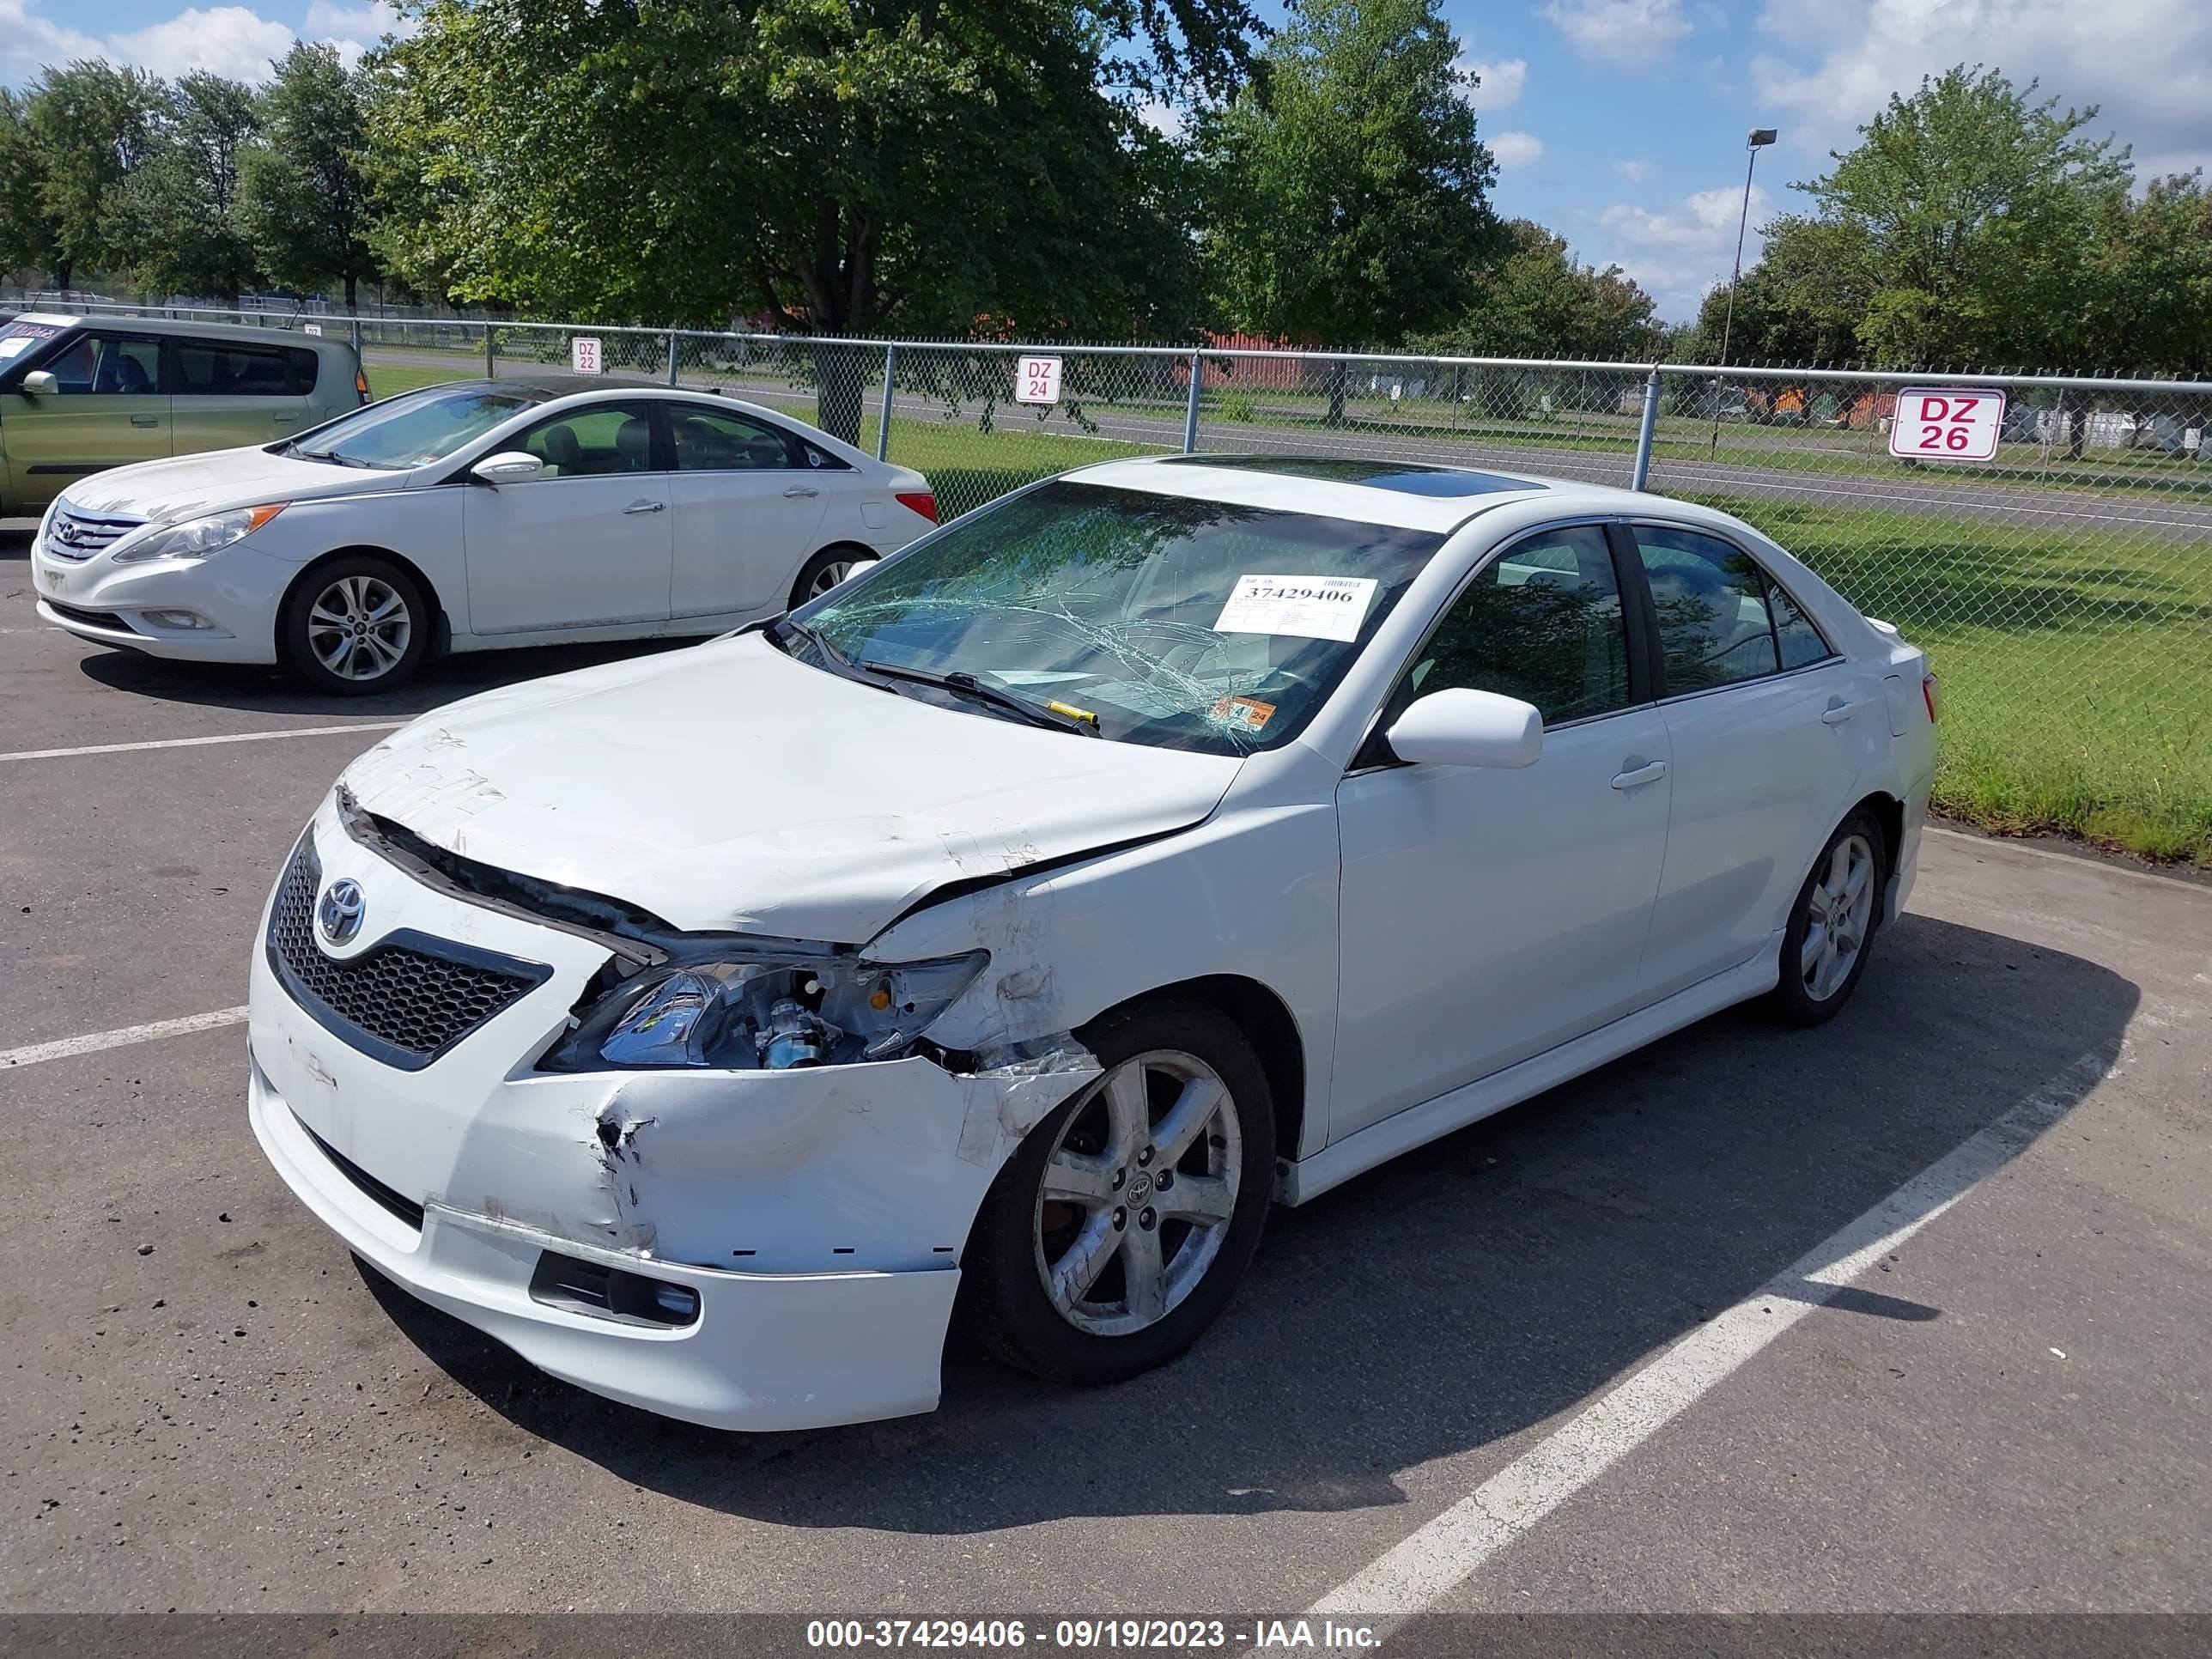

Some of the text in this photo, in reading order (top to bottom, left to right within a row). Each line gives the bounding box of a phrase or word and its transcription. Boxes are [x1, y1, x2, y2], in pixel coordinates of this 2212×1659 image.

[579, 343, 594, 355] DZ
[580, 356, 594, 368] 22
[1029, 362, 1052, 379] DZ
[1029, 380, 1047, 397] 24
[1920, 398, 1979, 423] DZ
[1918, 425, 1969, 451] 26
[1244, 587, 1354, 603] 37429406
[1251, 711, 1267, 720] 24
